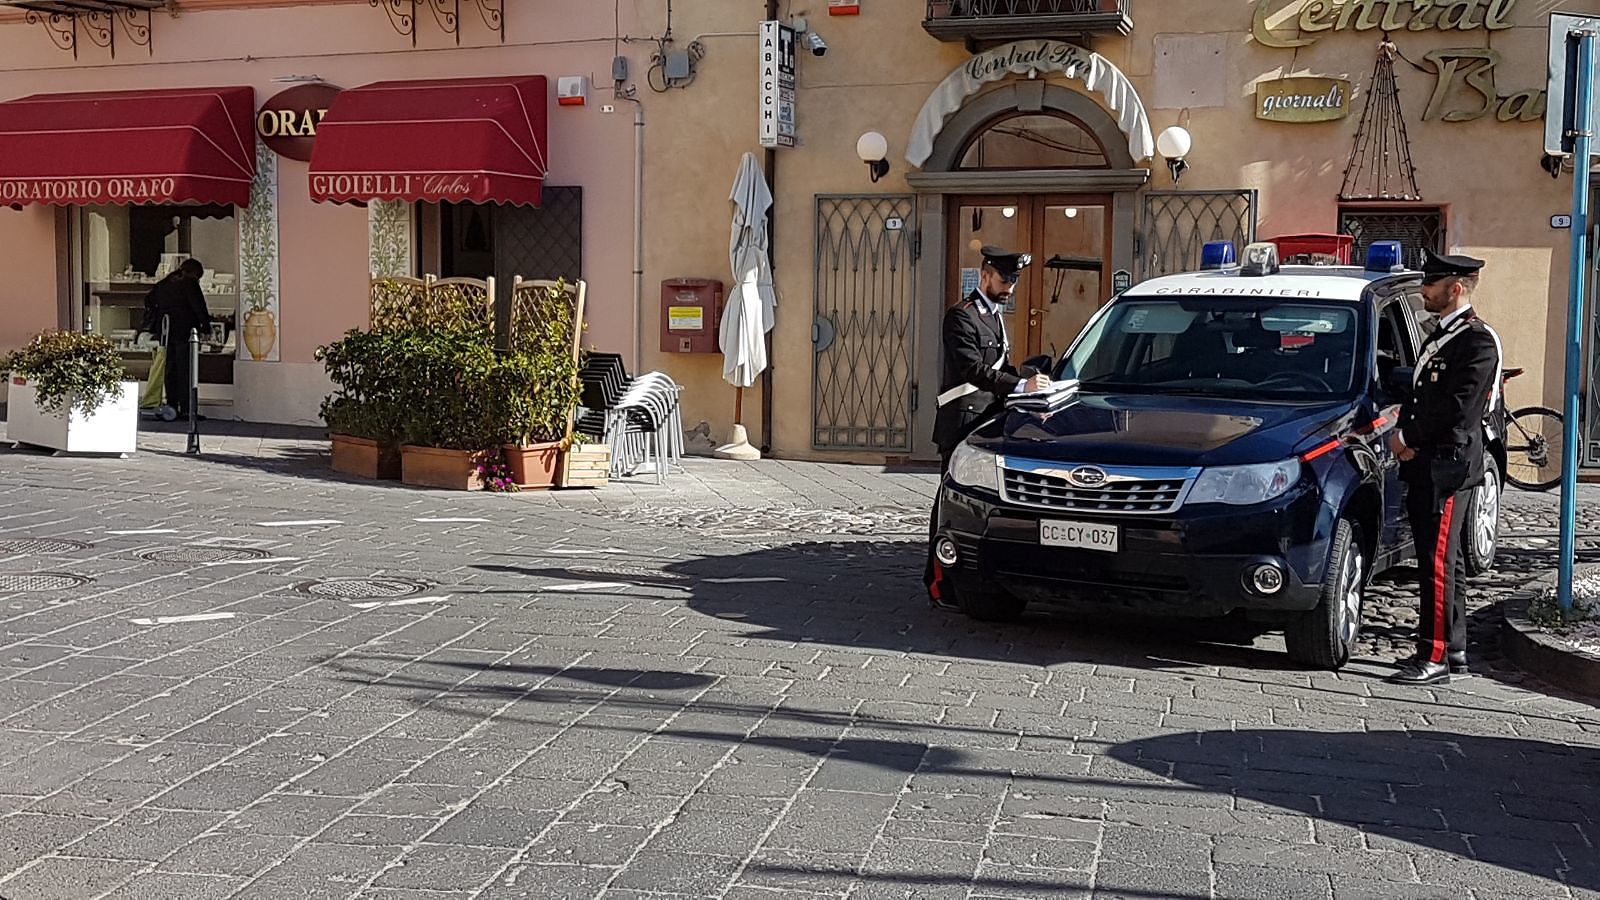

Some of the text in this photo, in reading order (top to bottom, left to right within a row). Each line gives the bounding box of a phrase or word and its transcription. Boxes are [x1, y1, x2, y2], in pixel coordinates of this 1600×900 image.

[1253, 0, 1514, 48] Central
[764, 23, 773, 134] TABACCHI
[967, 42, 1050, 80] Central
[1263, 84, 1344, 116] giornali
[1421, 48, 1547, 122] Ba
[0, 177, 175, 200] ORATORIO ORAFO
[313, 175, 412, 195] GIOIELLI
[1155, 287, 1321, 297] CARABINIERI
